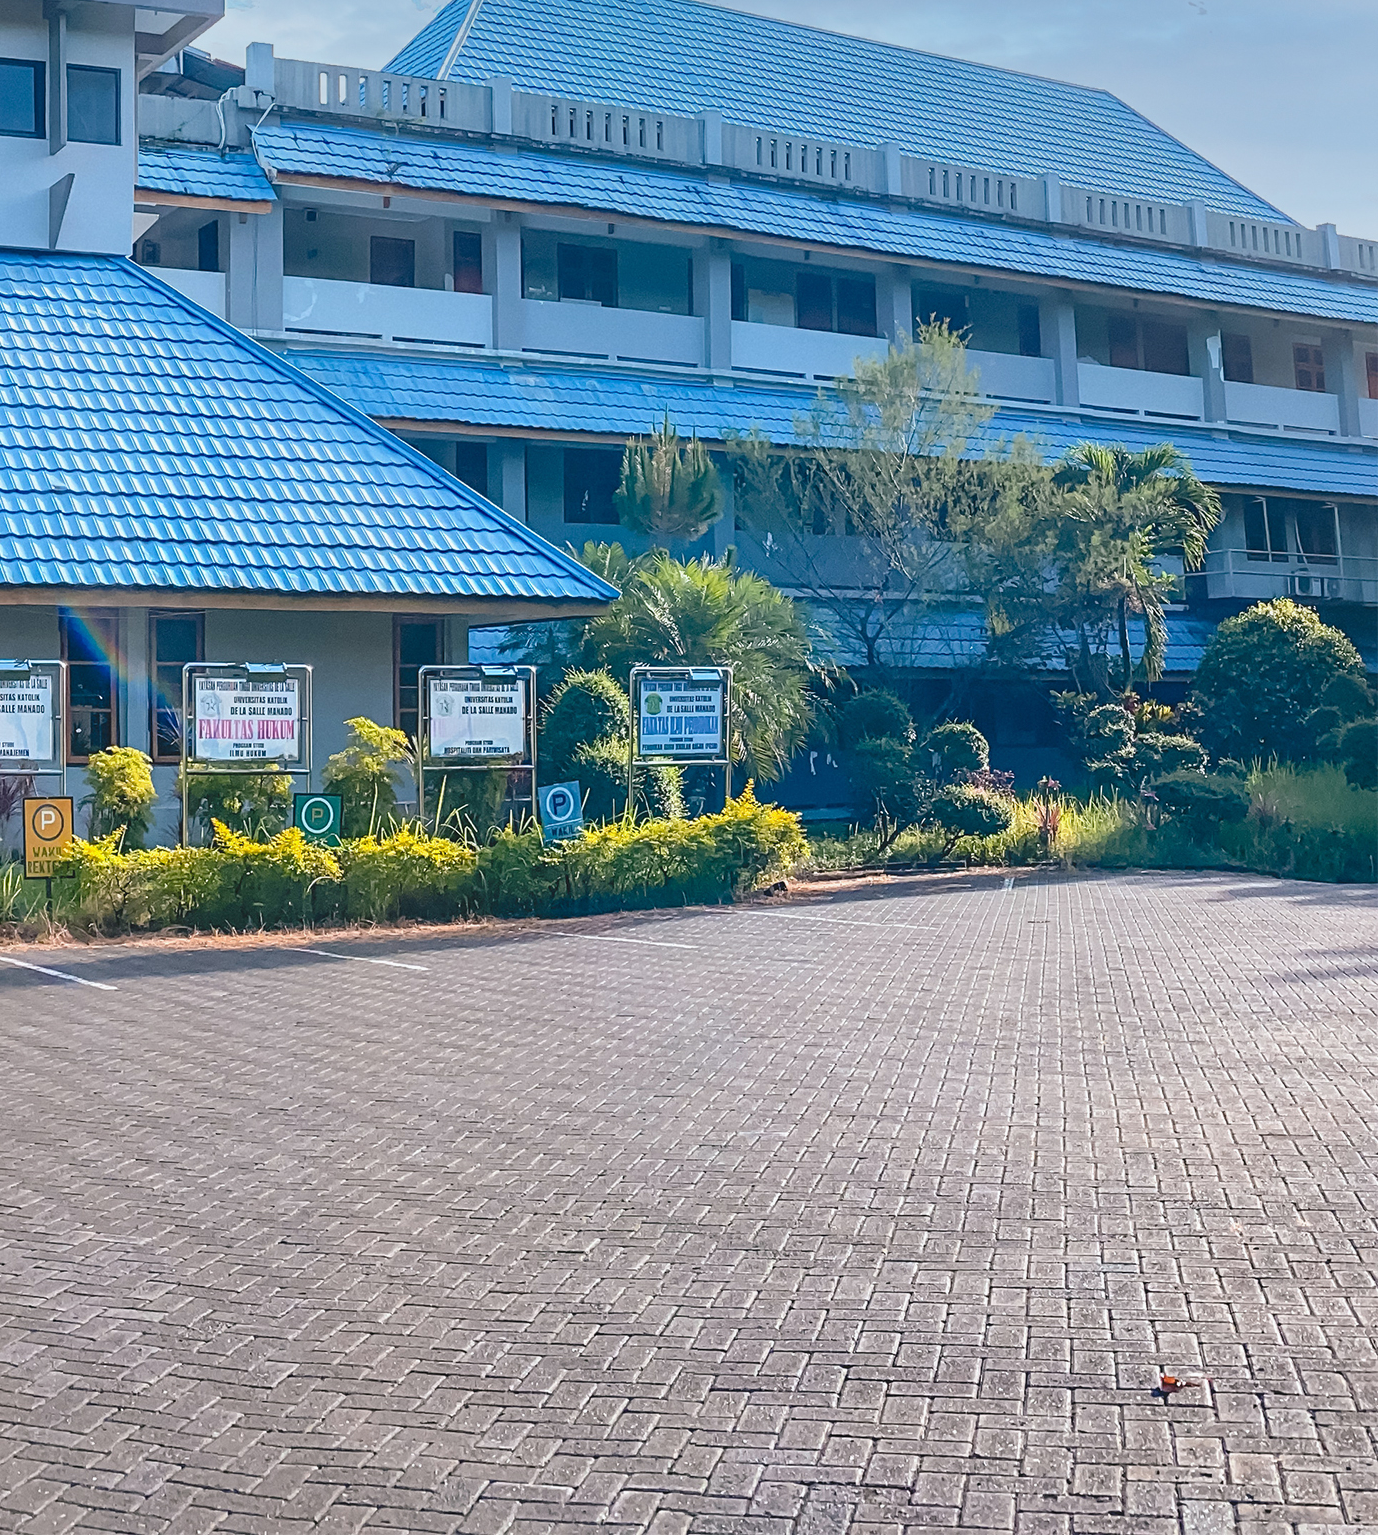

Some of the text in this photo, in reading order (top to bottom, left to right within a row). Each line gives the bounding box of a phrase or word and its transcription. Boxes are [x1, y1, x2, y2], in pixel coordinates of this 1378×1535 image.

[234, 696, 266, 704] UNIVERSITAS
[17, 705, 45, 714] MANADO
[230, 707, 292, 715] DE LA SALLE MANADO
[462, 706, 468, 714] DE
[470, 706, 477, 714] LA
[479, 706, 494, 714] SALLE
[199, 719, 295, 739] FAKULTAS HUKUM
[311, 808, 324, 823] P
[41, 810, 56, 831] P
